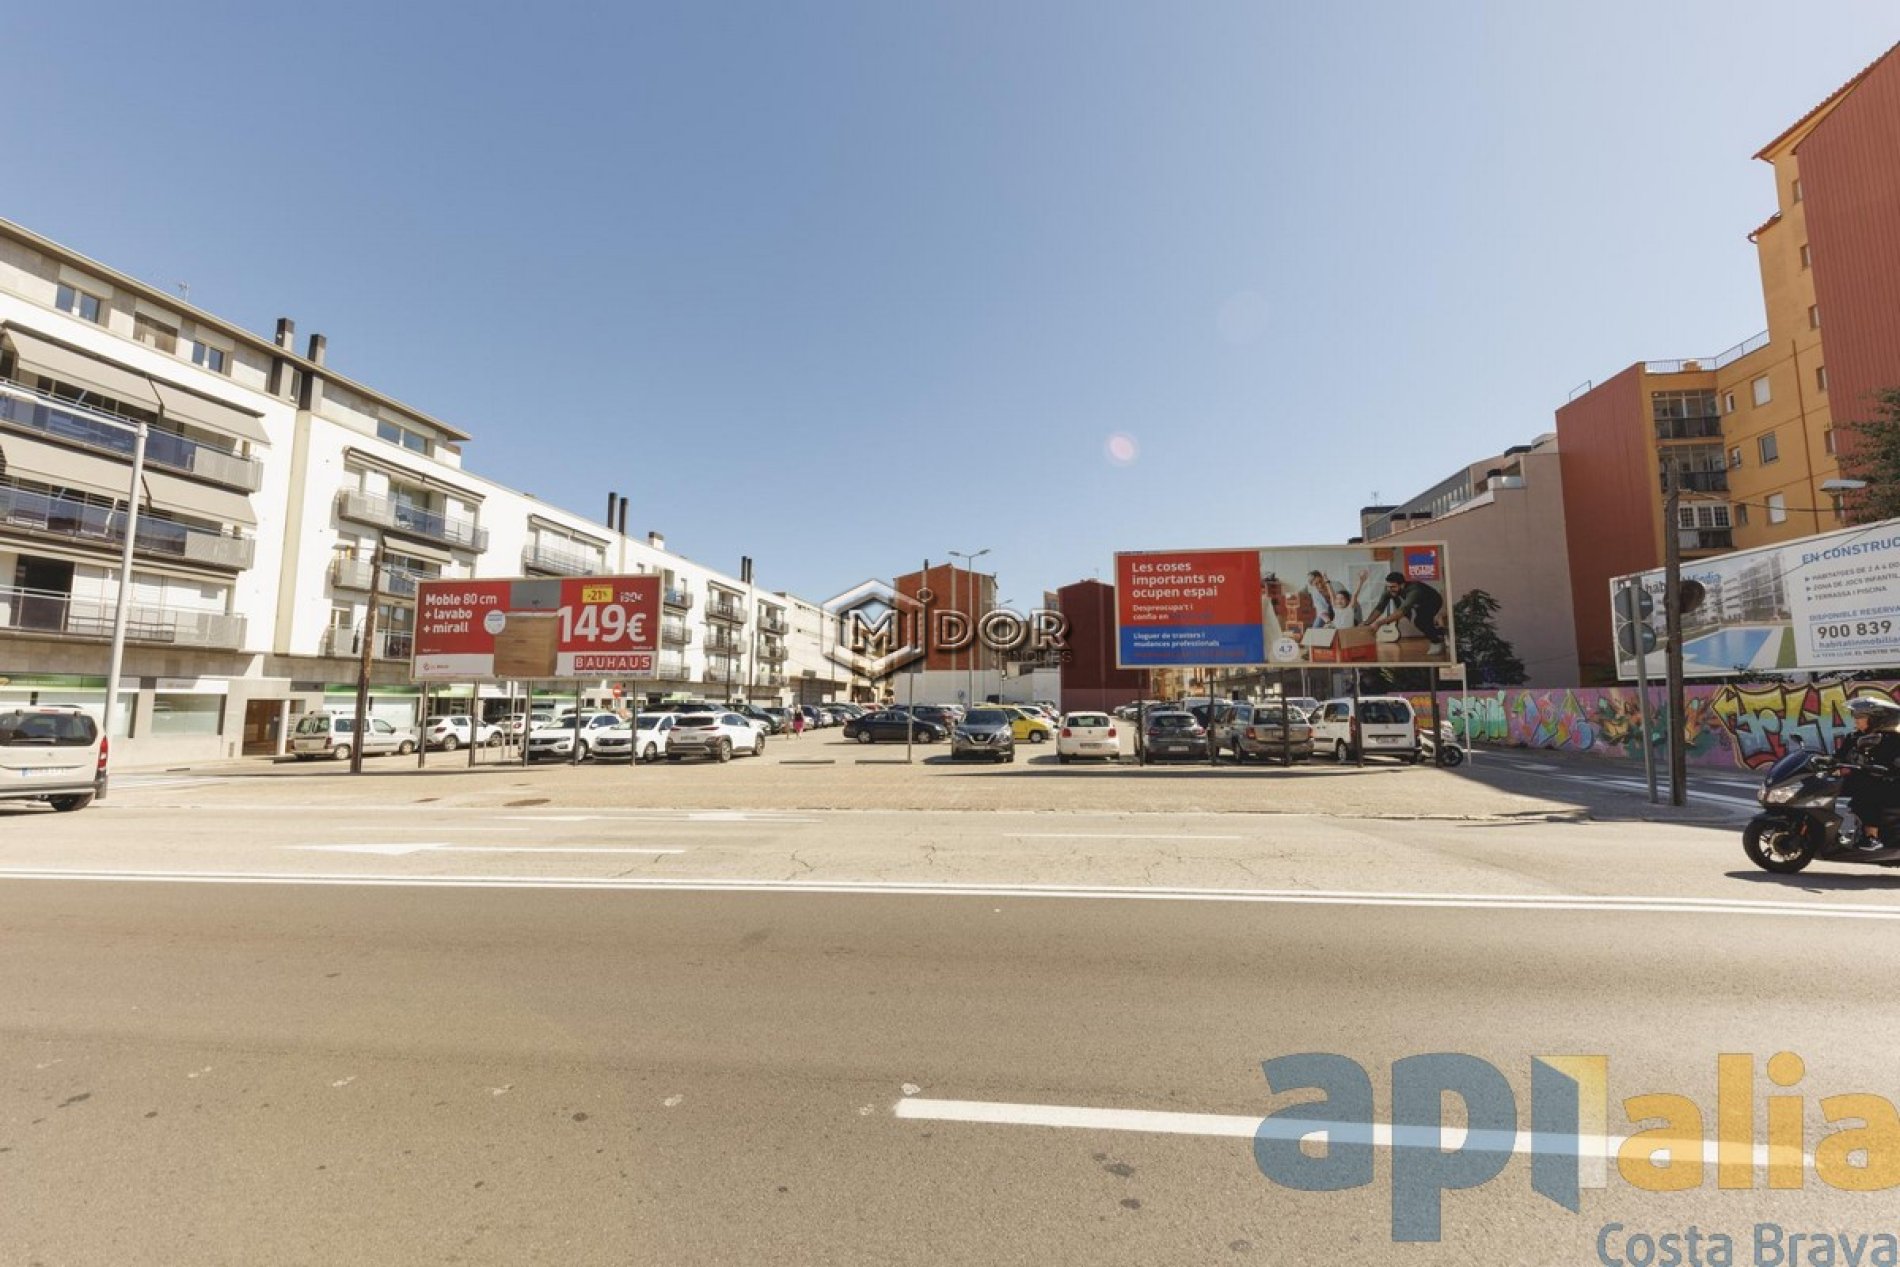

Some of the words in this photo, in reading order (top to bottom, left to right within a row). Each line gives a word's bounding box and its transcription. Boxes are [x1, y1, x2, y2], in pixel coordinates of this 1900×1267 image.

[1801, 553, 1820, 565] EN
[1132, 562, 1154, 572] Les
[1156, 562, 1192, 572] coses
[1132, 573, 1205, 587] importants
[1208, 573, 1225, 584] no
[425, 593, 462, 606] Moble
[463, 592, 478, 605] 80
[479, 594, 498, 605] cm
[1132, 587, 1180, 600] ocupen
[1183, 585, 1218, 599] espai
[433, 607, 473, 620] lavabo
[432, 621, 469, 633] mirall
[556, 604, 647, 644] 149€
[1817, 624, 1850, 639] 900
[1856, 620, 1892, 636] 839
[575, 655, 651, 669] BAUHAUS
